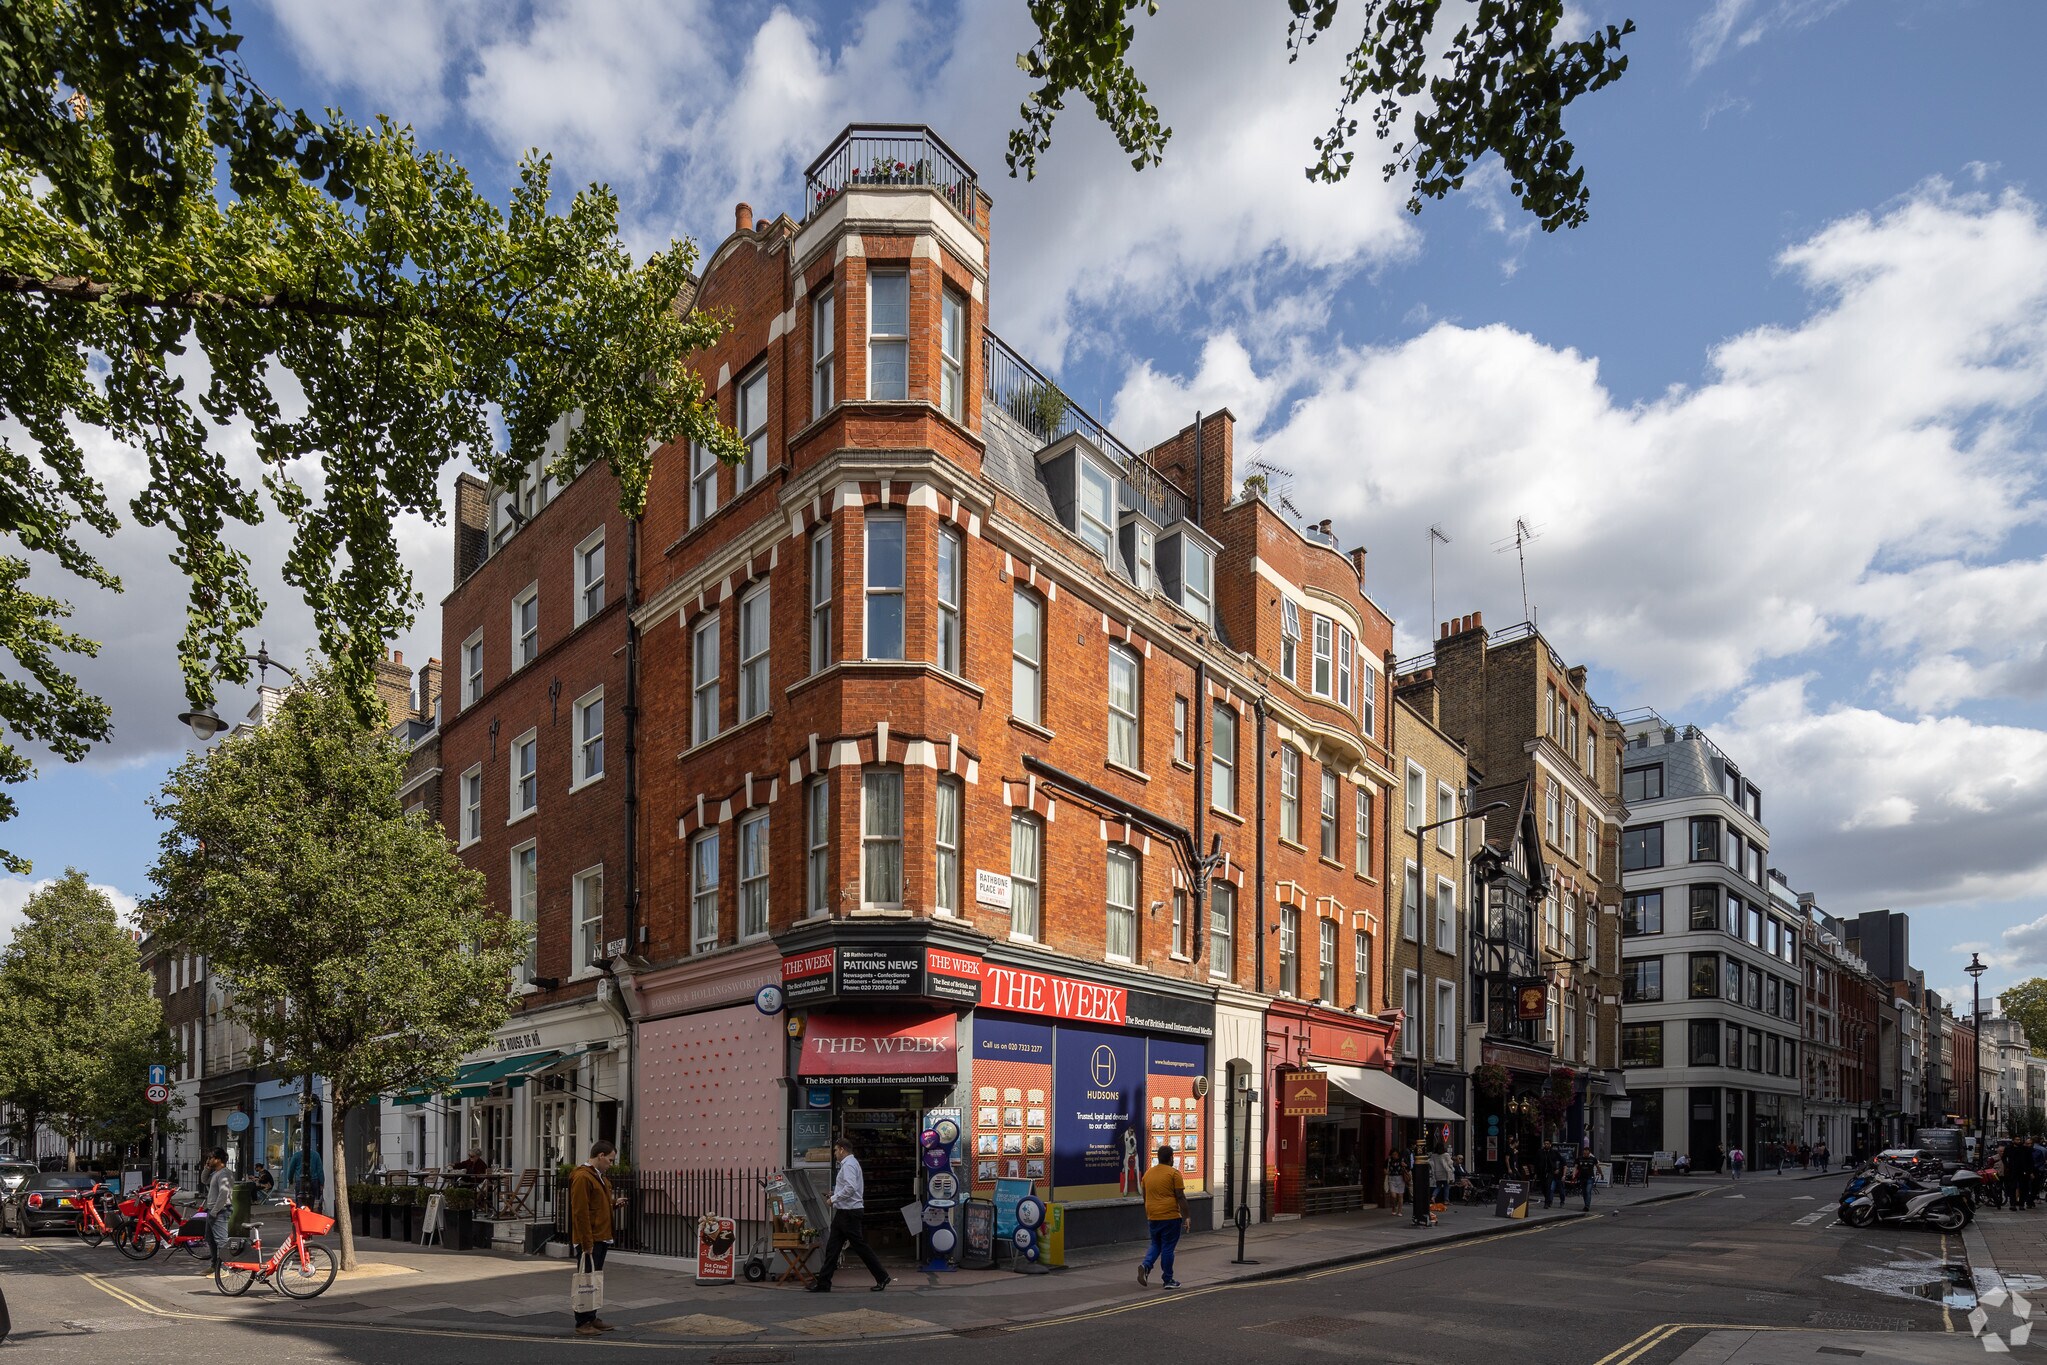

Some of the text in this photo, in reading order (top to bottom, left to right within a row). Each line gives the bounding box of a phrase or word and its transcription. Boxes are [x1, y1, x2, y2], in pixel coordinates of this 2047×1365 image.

[980, 873, 1008, 888] RATHBONE
[980, 882, 1005, 896] PLACE W1
[608, 946, 622, 956] STREET
[611, 940, 623, 949] PERCY
[784, 954, 832, 975] THE WEEK
[843, 961, 918, 970] PATKINS NEWS
[930, 954, 980, 975] THE WEEK
[935, 985, 962, 995] International
[955, 981, 968, 989] British
[652, 995, 683, 1008] BOURNE
[692, 978, 764, 1000] HOLLINGSWORTH
[788, 988, 813, 997] International
[987, 968, 1122, 1022] THE WEEK
[1125, 1016, 1134, 1024] The
[1135, 1017, 1144, 1026] Best
[1150, 1019, 1165, 1028] British
[1174, 1023, 1200, 1034] International
[1201, 1027, 1212, 1036] Media
[506, 1036, 524, 1050] HOUSE
[524, 1034, 531, 1047] OF
[812, 1036, 949, 1053] THE WEEK
[1087, 1090, 1119, 1100] HUDSONS
[1076, 1112, 1094, 1120] Trusted,
[1094, 1112, 1104, 1122] loyal
[799, 1125, 826, 1134] SALE
[272, 1236, 292, 1265] JUMP
